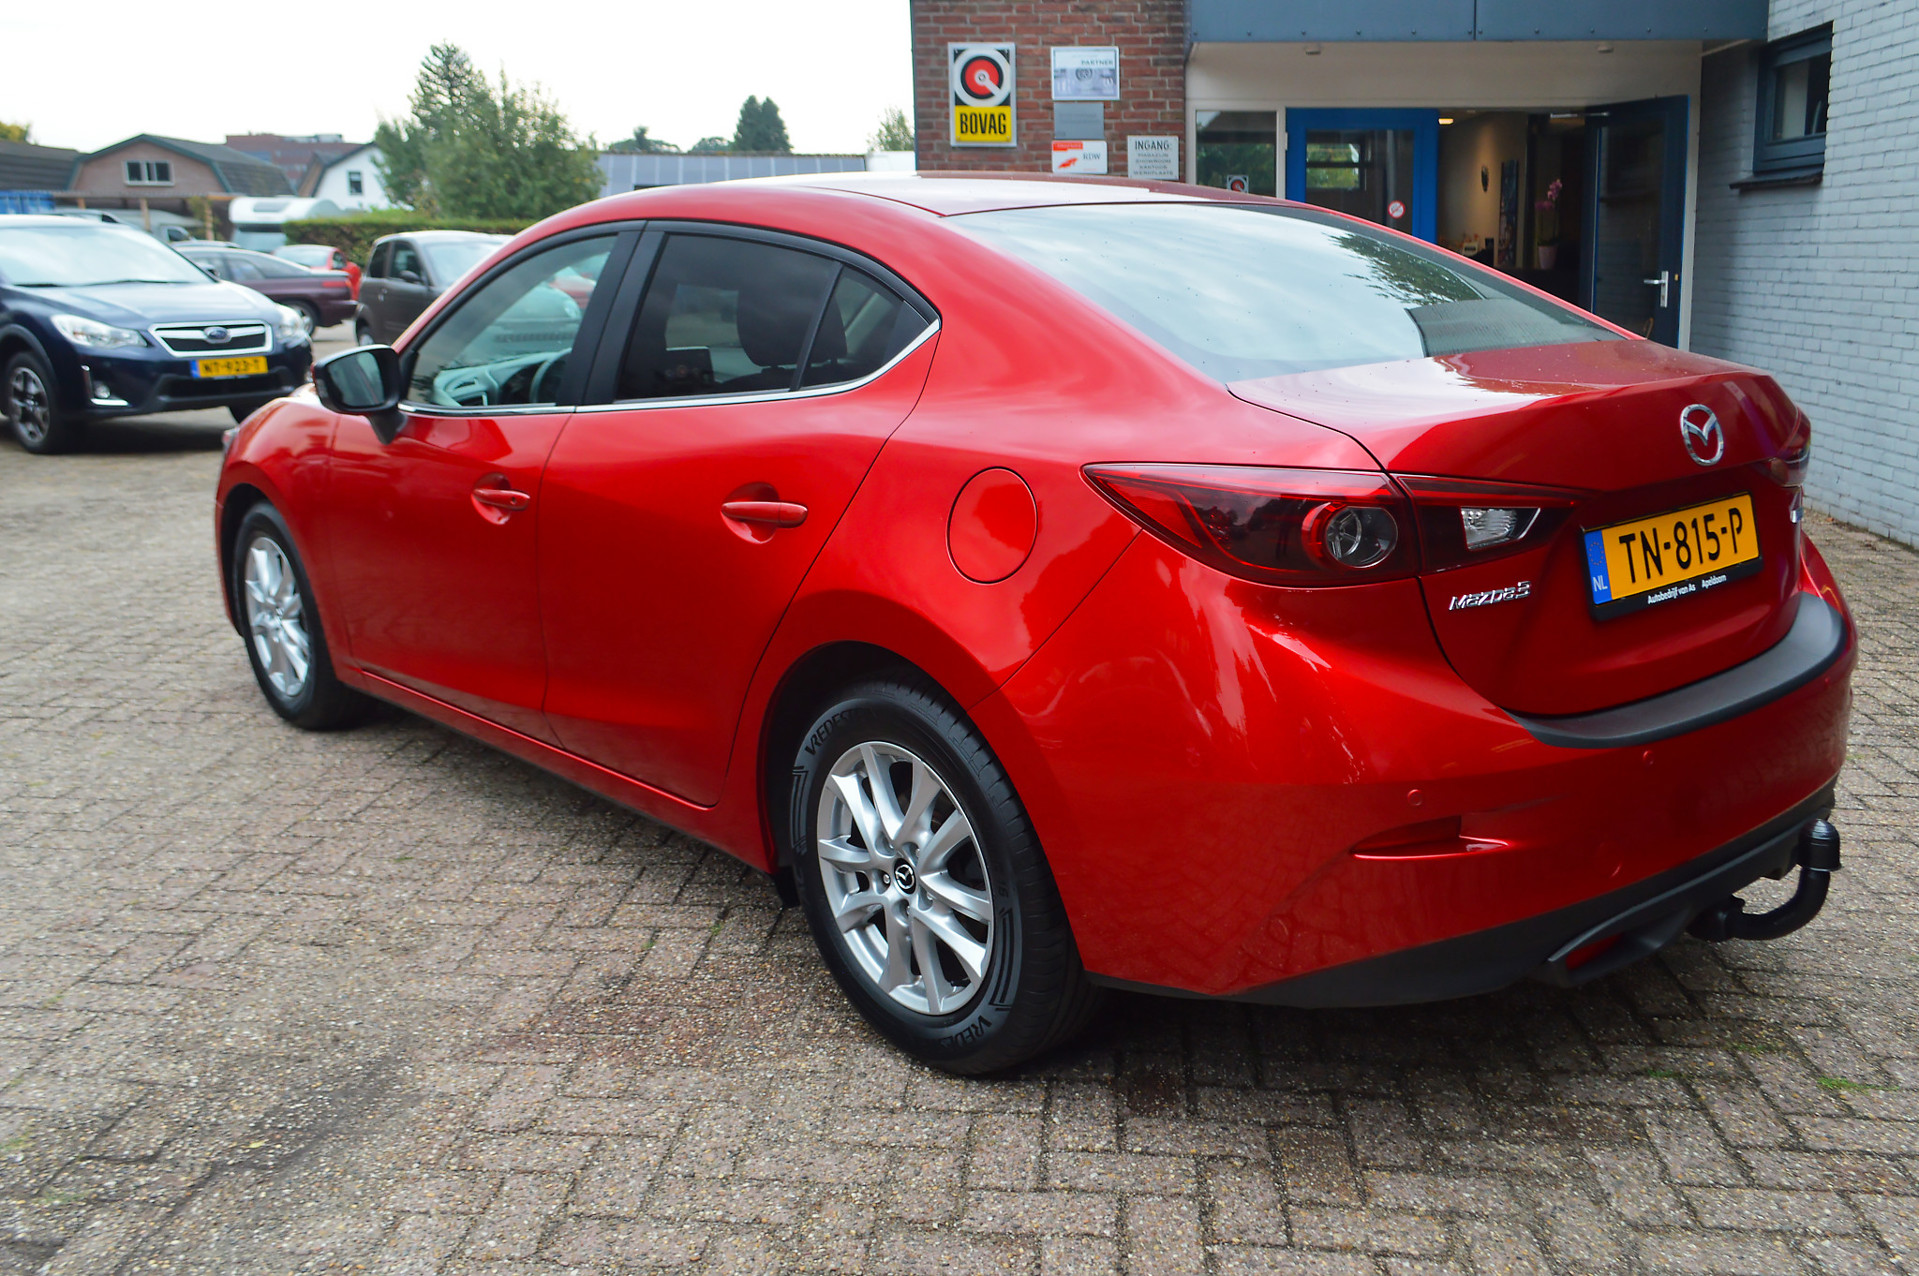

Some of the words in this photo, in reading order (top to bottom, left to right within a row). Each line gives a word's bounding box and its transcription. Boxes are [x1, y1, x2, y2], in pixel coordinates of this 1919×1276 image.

[960, 112, 1006, 135] BOVAG
[1618, 507, 1743, 583] TN-815-P
[1592, 575, 1608, 592] NL
[1647, 586, 1678, 604] Autobedrijf
[1677, 585, 1689, 595] van
[1688, 583, 1696, 592] As
[1701, 574, 1727, 589] Apeldoorn
